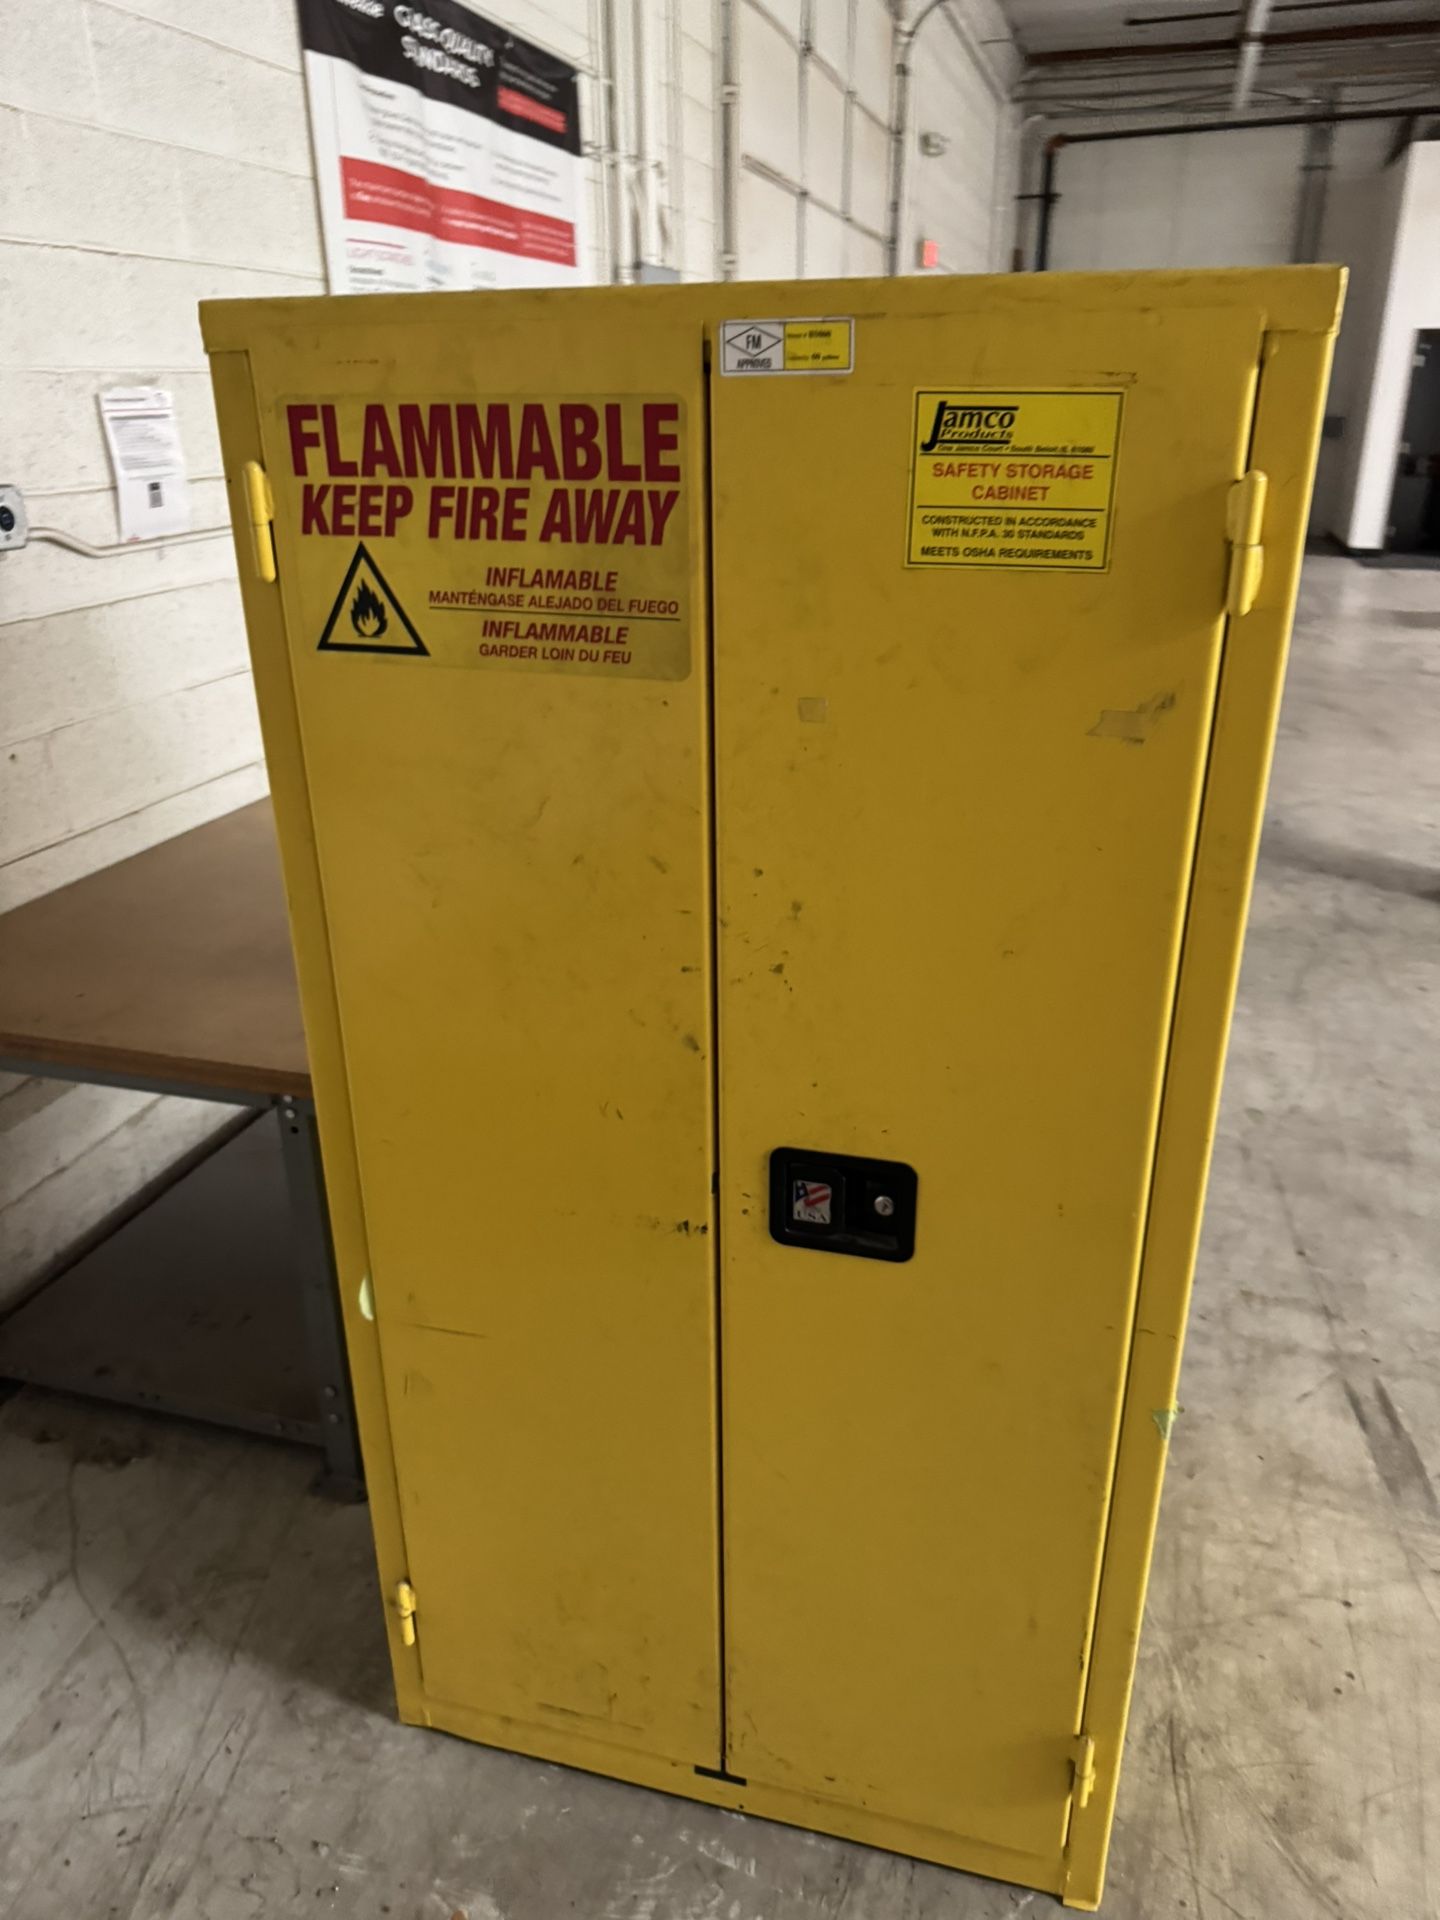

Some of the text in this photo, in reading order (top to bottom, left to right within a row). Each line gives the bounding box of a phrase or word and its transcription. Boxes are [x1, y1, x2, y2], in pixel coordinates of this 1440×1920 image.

[746, 334, 762, 349] FM
[737, 357, 772, 368] APPROVED
[921, 401, 1016, 452] Jamco
[940, 428, 1014, 439] Products
[286, 403, 681, 482] FLAMMABLE
[933, 462, 1094, 479] SAFETY STORAGE
[971, 485, 1050, 501] CABINET
[302, 484, 680, 546] KEEP FIRE AWAY
[922, 515, 1097, 528] CONSTRUCTED IN ACCORDANCE
[932, 528, 958, 537] WITH
[1017, 529, 1085, 540] STANDARDS
[921, 546, 1094, 560] MEETS OSHA REQUIREMENTS
[485, 566, 618, 592] INFLAMABLE
[429, 589, 679, 614] MANTÉNGASE ALEJADO DEL FUEGO
[481, 620, 630, 645] INFLAMMABLE
[479, 643, 632, 664] GARDER LOIN DU FEU
